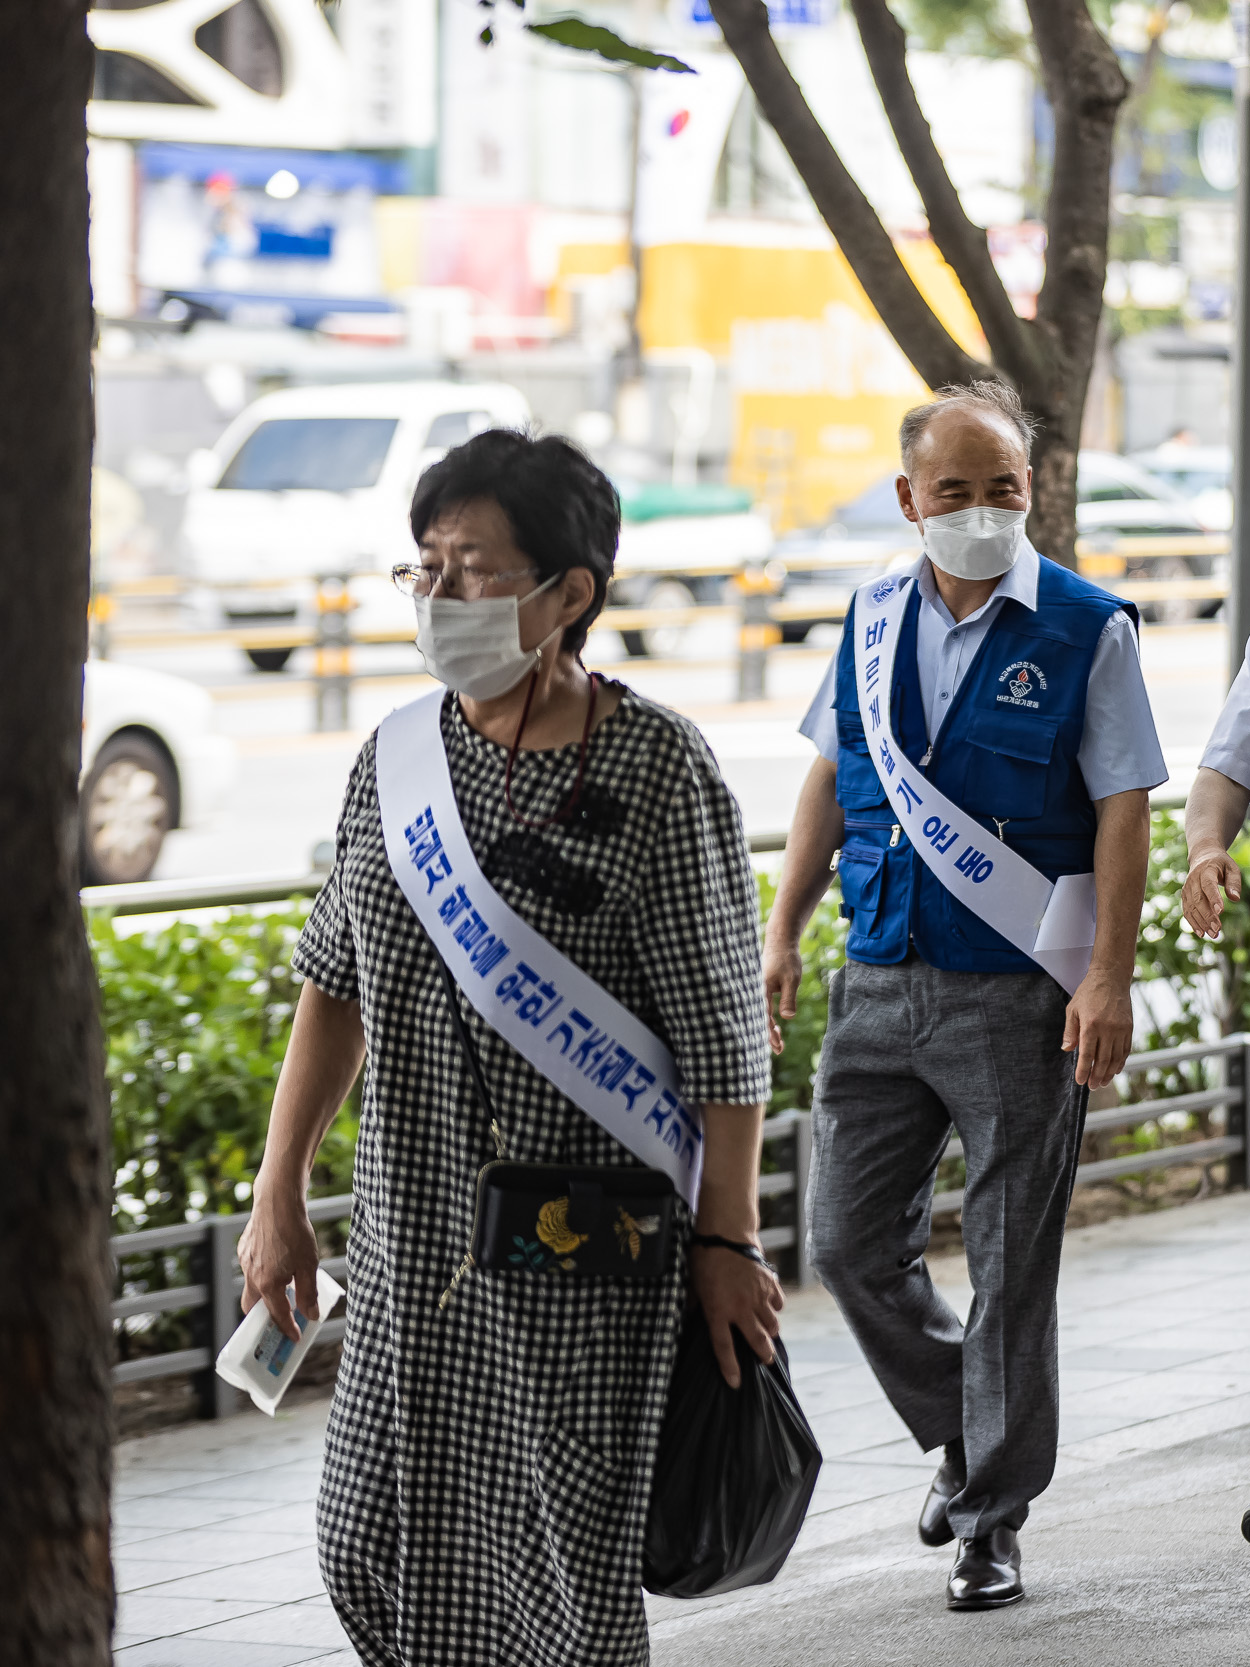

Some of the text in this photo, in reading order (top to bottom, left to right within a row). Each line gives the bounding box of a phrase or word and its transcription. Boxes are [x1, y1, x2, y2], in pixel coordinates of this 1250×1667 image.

[404, 805, 703, 1169] 법질서 확립을 위한 기초질서 지키기
